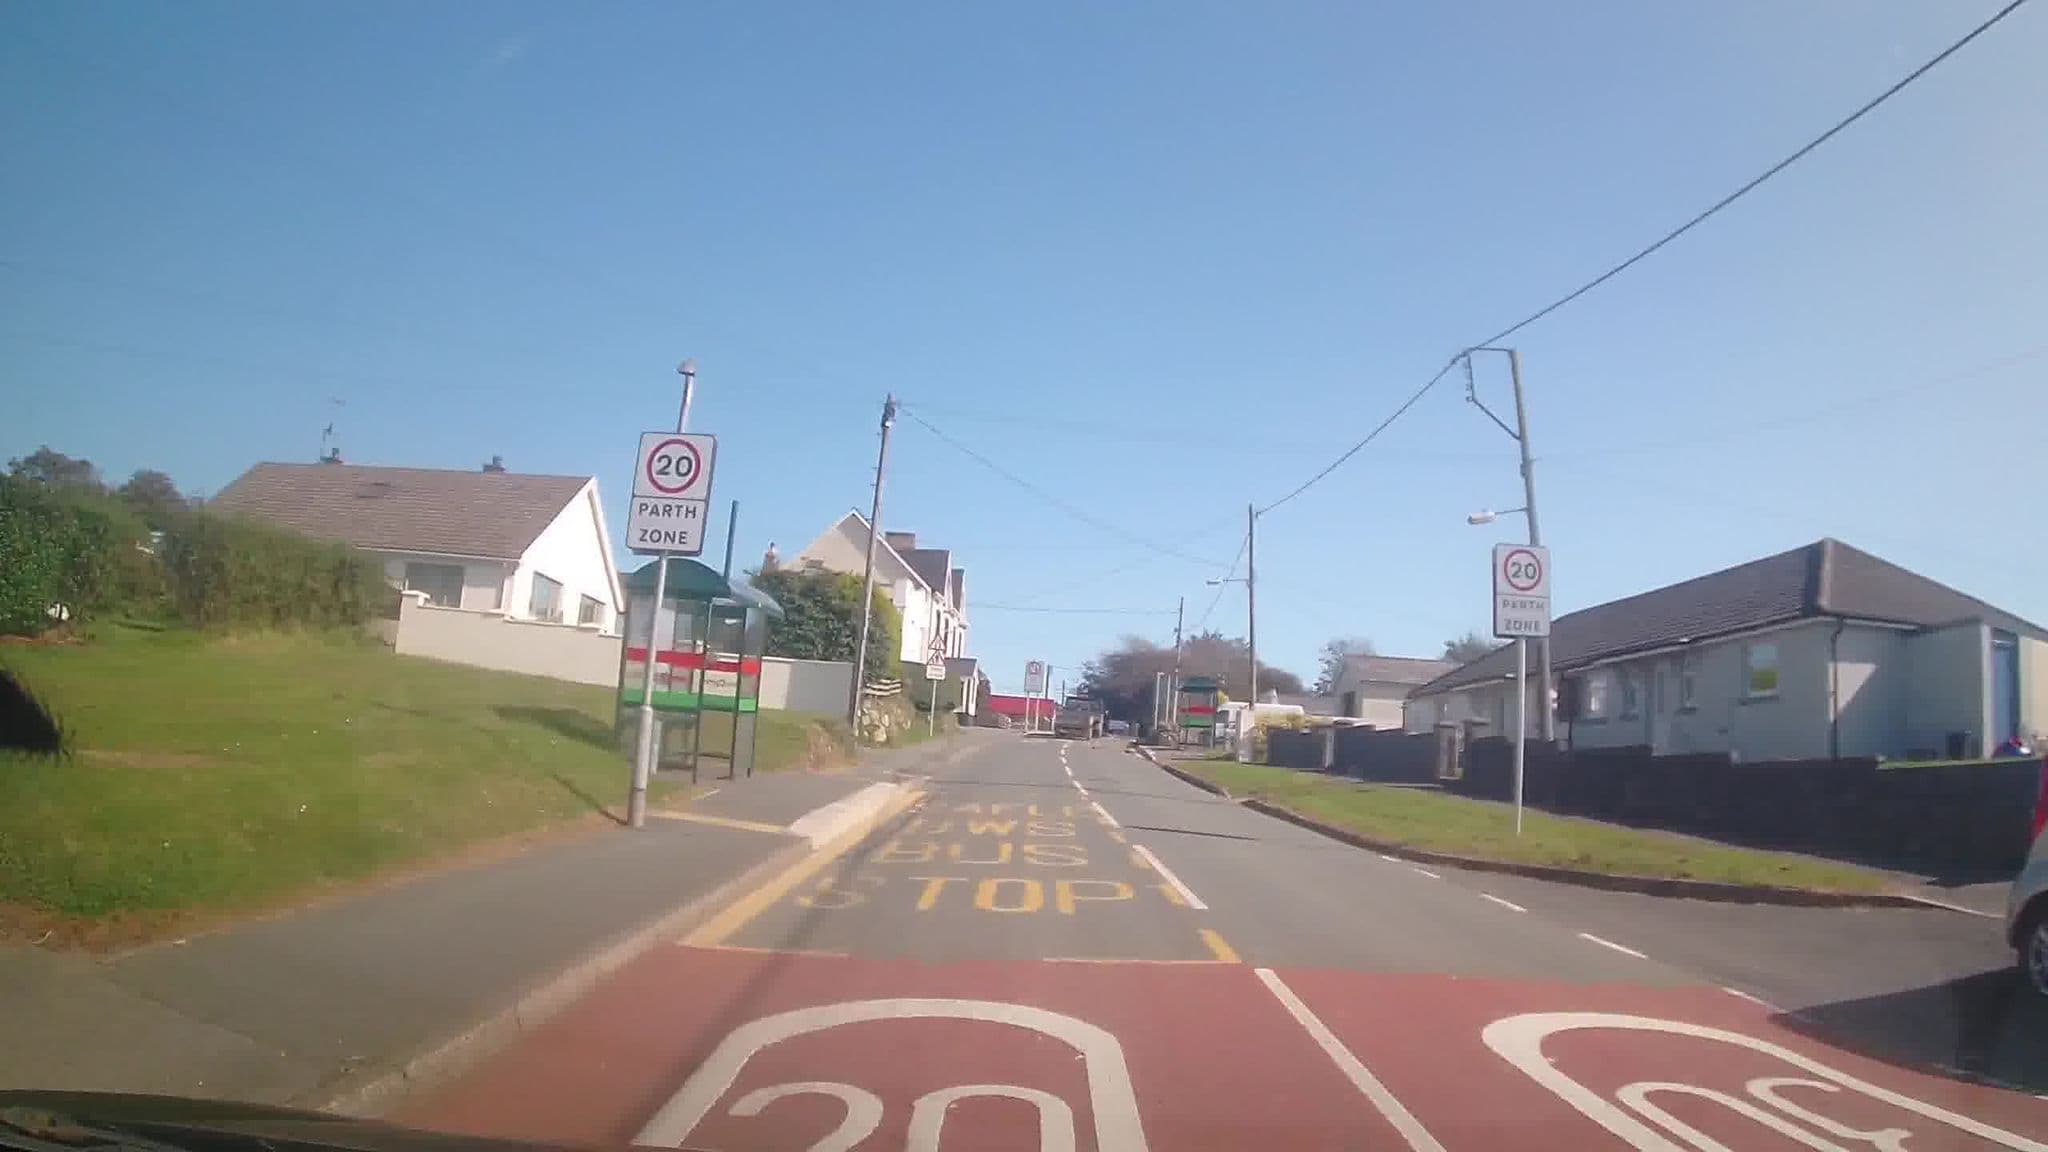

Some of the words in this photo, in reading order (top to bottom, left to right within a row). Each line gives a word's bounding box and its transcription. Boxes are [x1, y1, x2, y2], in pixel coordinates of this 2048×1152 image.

[655, 454, 693, 477] 20
[638, 503, 697, 519] PARTH
[638, 528, 688, 544] ZONE
[1511, 561, 1537, 580] 20
[1504, 619, 1541, 632] ZONE
[794, 876, 1136, 915] STOP
